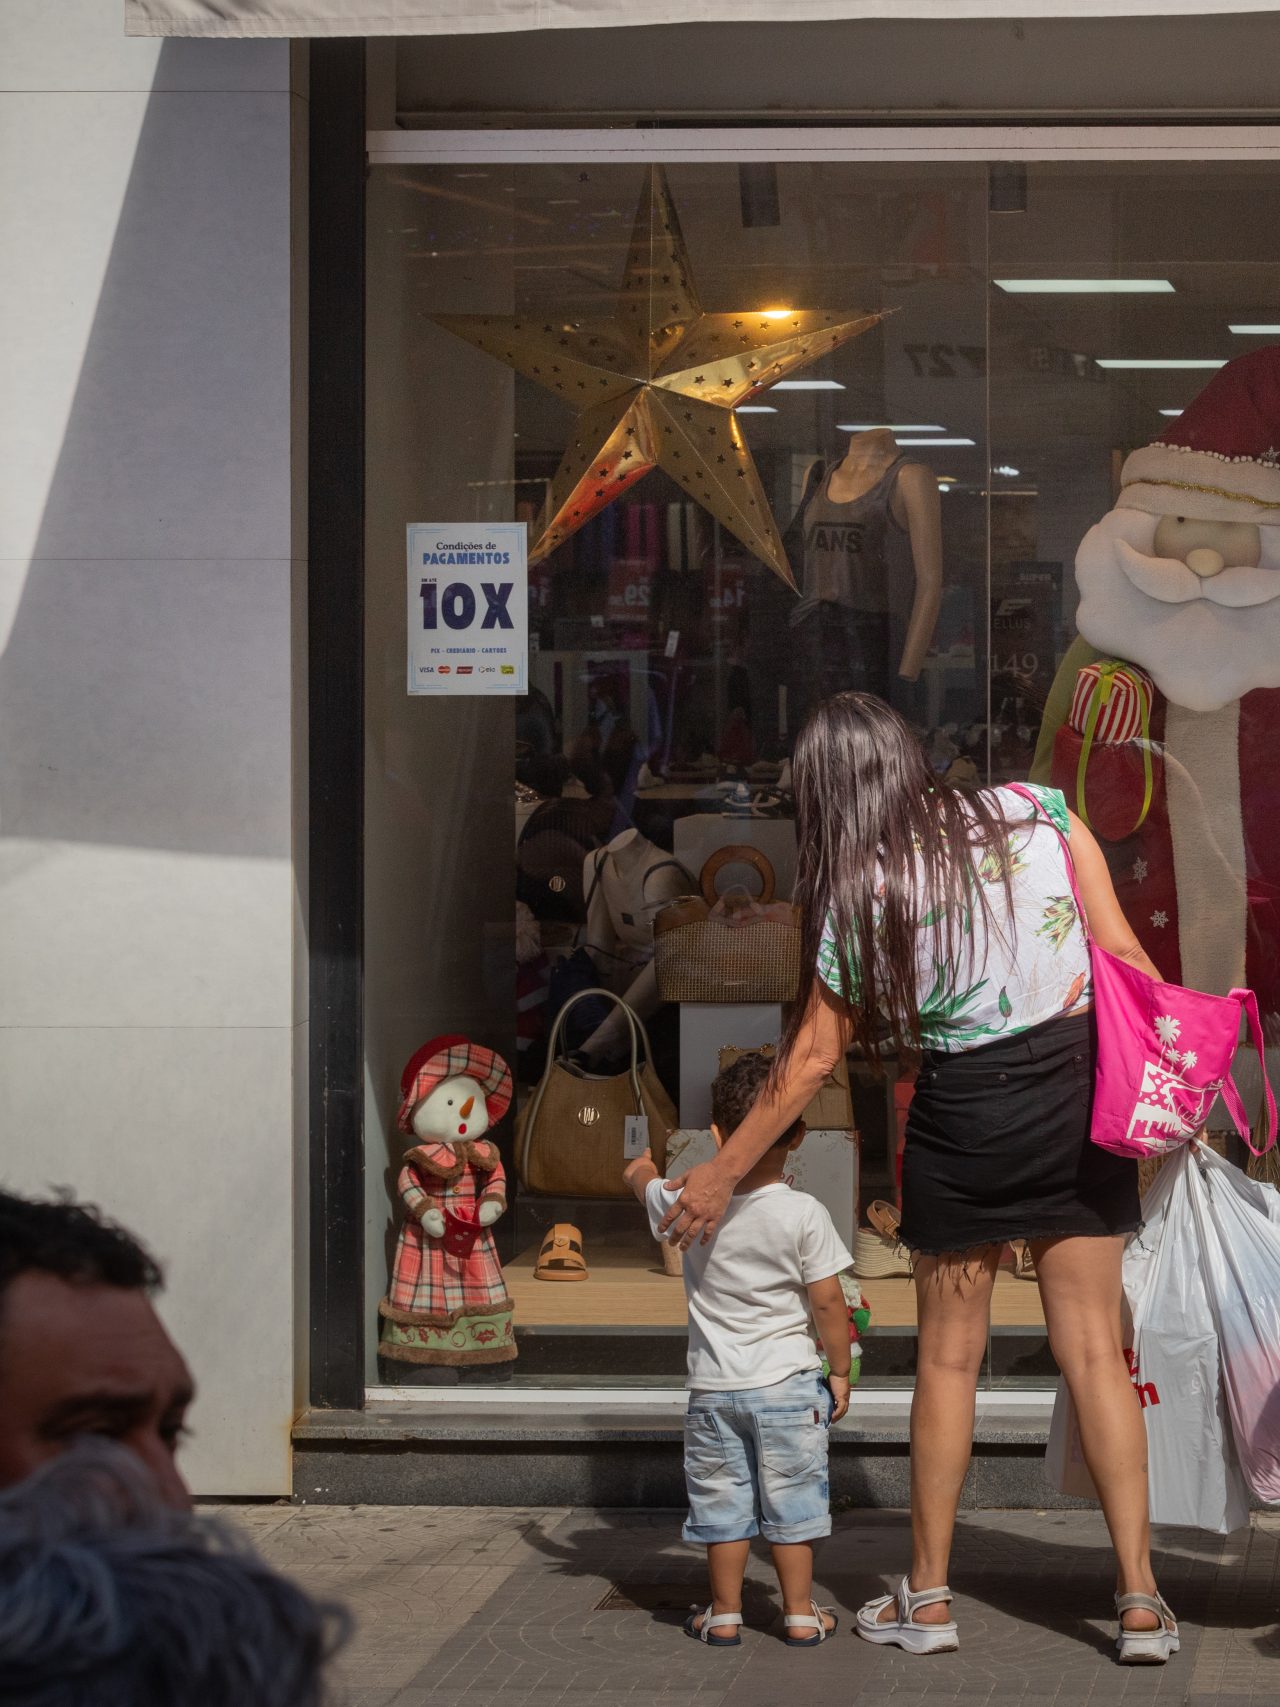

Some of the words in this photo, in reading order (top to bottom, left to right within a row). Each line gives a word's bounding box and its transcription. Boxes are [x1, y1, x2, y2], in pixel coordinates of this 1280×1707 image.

[436, 541, 483, 552] Condições
[486, 541, 497, 551] de
[423, 552, 510, 565] PAGAMENTOS
